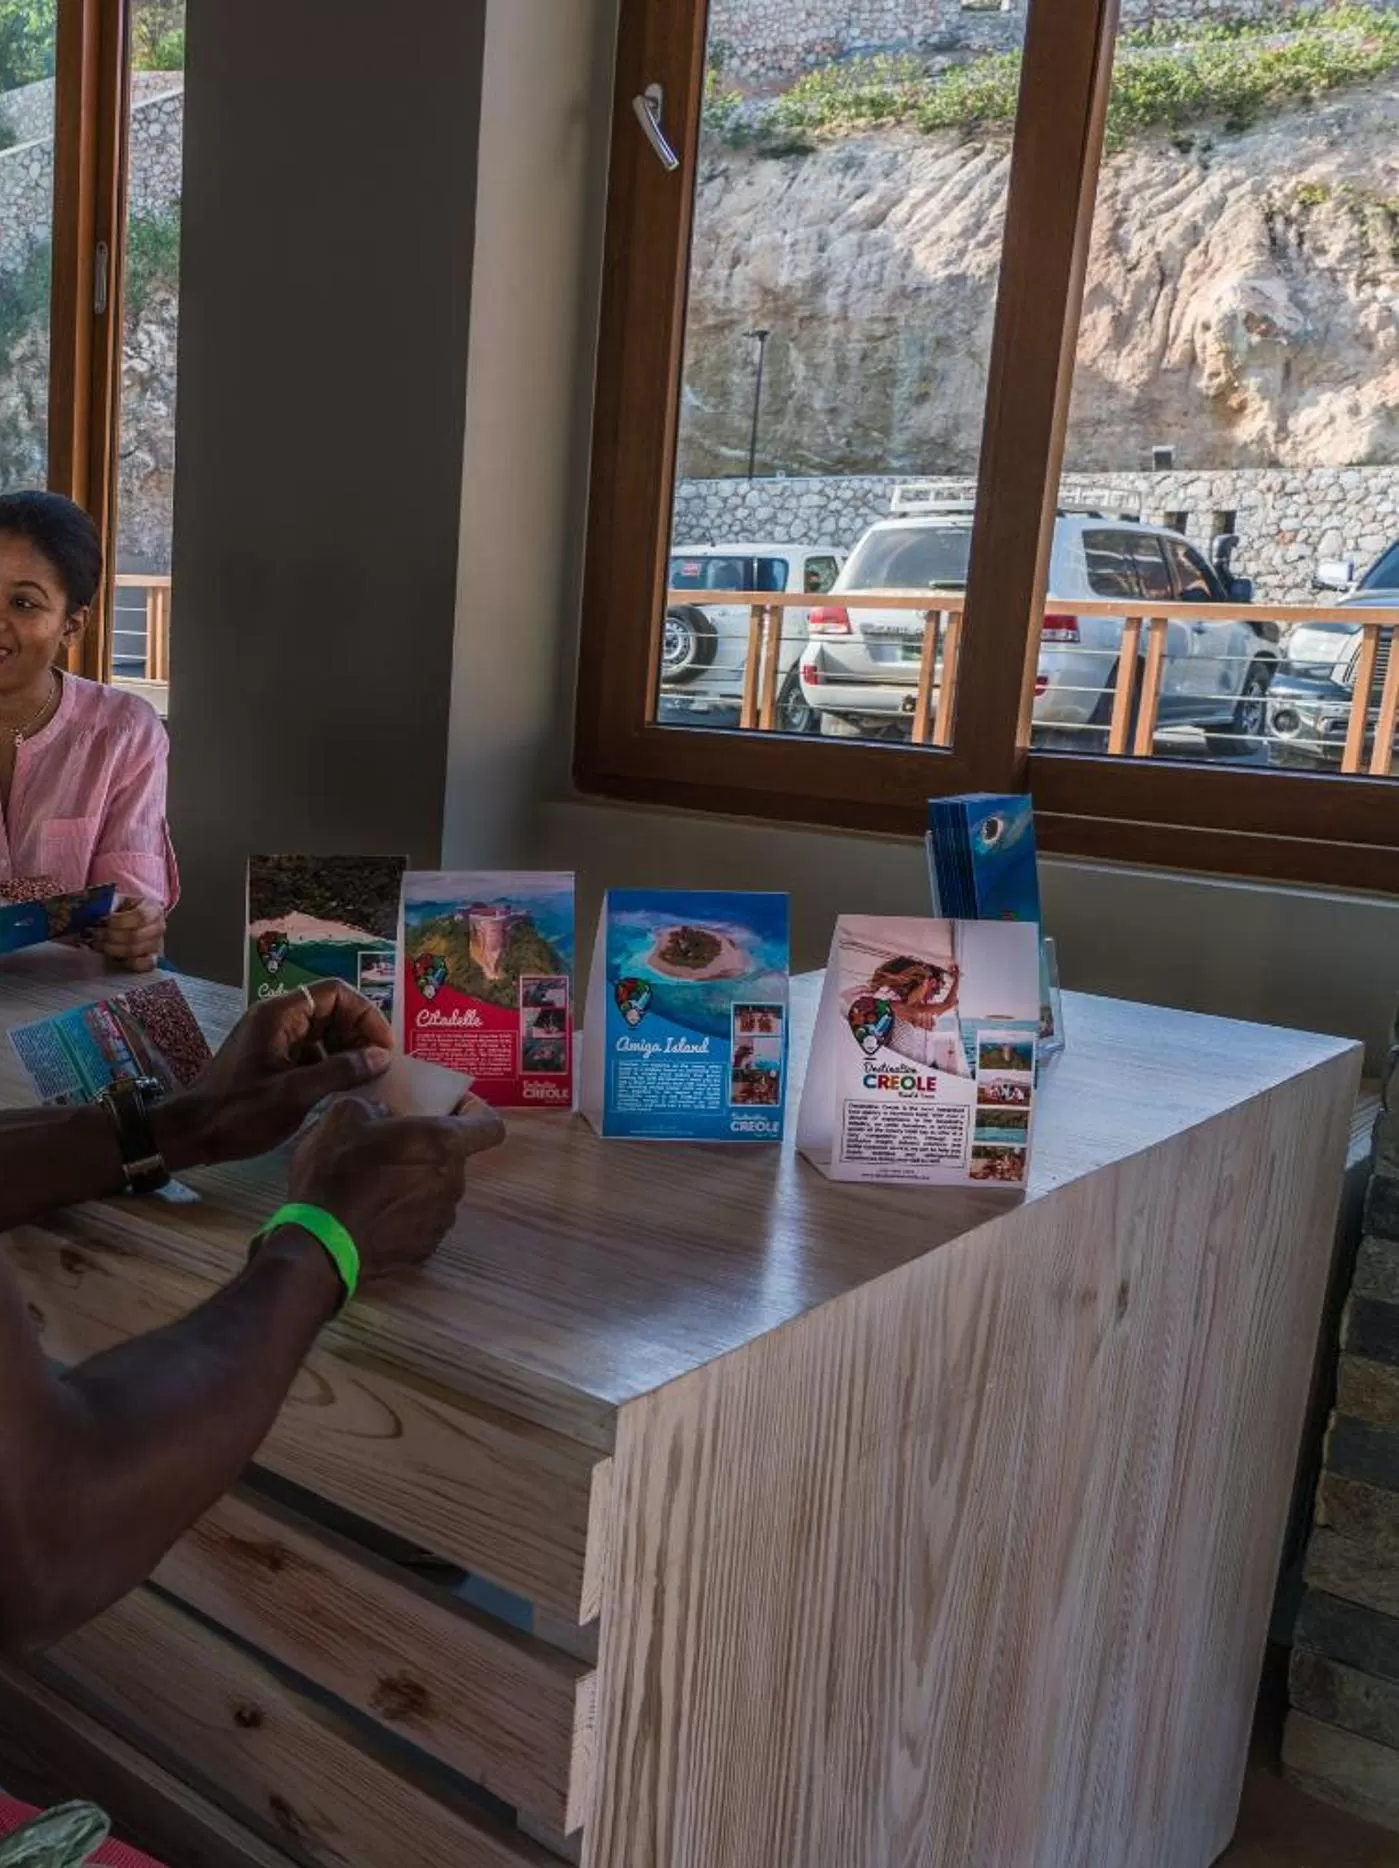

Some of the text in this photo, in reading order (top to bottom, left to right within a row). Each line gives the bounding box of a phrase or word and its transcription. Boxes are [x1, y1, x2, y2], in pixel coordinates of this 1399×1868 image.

[416, 1008, 484, 1027] Citadelle
[663, 1037, 710, 1053] Island
[863, 1074, 936, 1091] CREOLE
[730, 1121, 779, 1132] CREOLE
